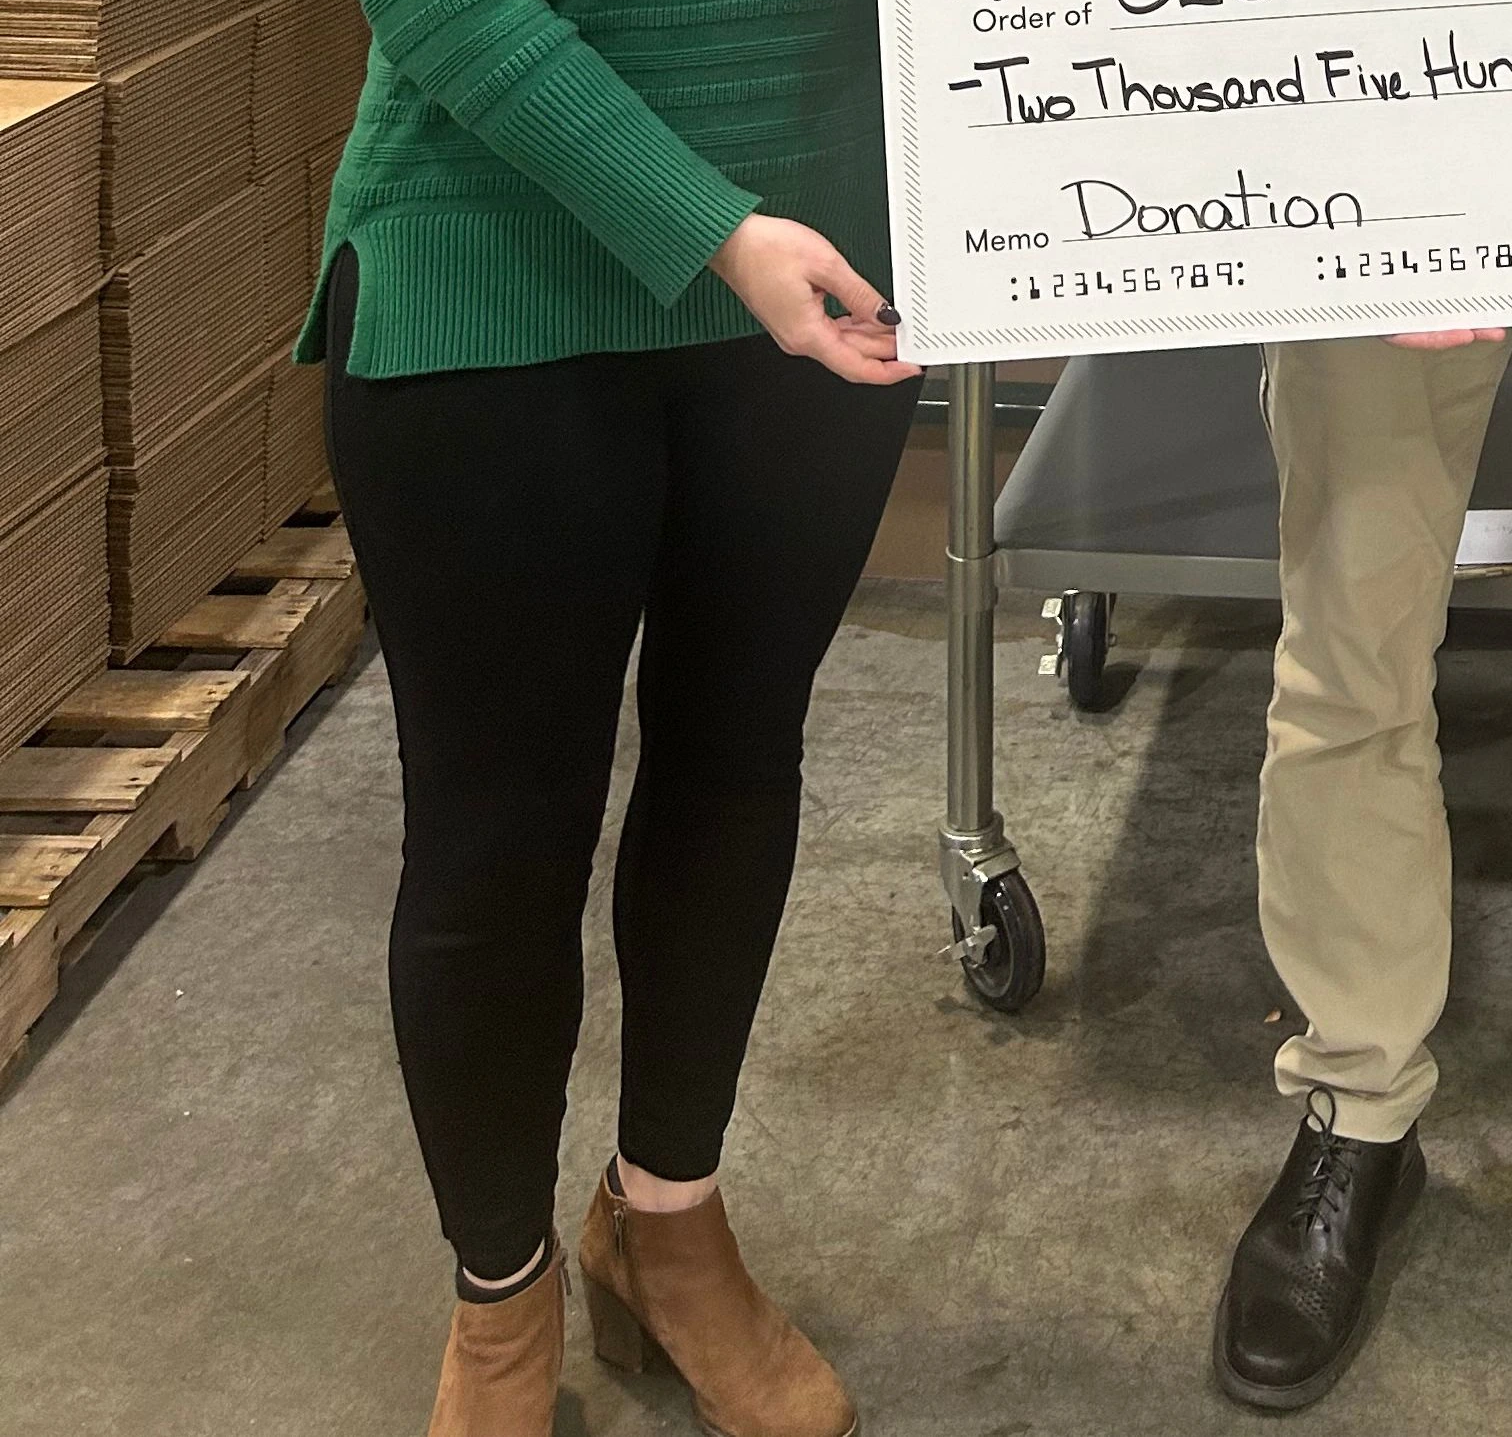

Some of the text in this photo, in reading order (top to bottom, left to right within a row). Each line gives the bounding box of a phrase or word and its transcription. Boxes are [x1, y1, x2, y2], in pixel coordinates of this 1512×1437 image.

[972, 0, 1093, 33] Order of
[1072, 56, 1306, 113] Thousand
[1315, 50, 1411, 100] Five
[1060, 169, 1363, 240] Donation
[965, 228, 1049, 254] Memo
